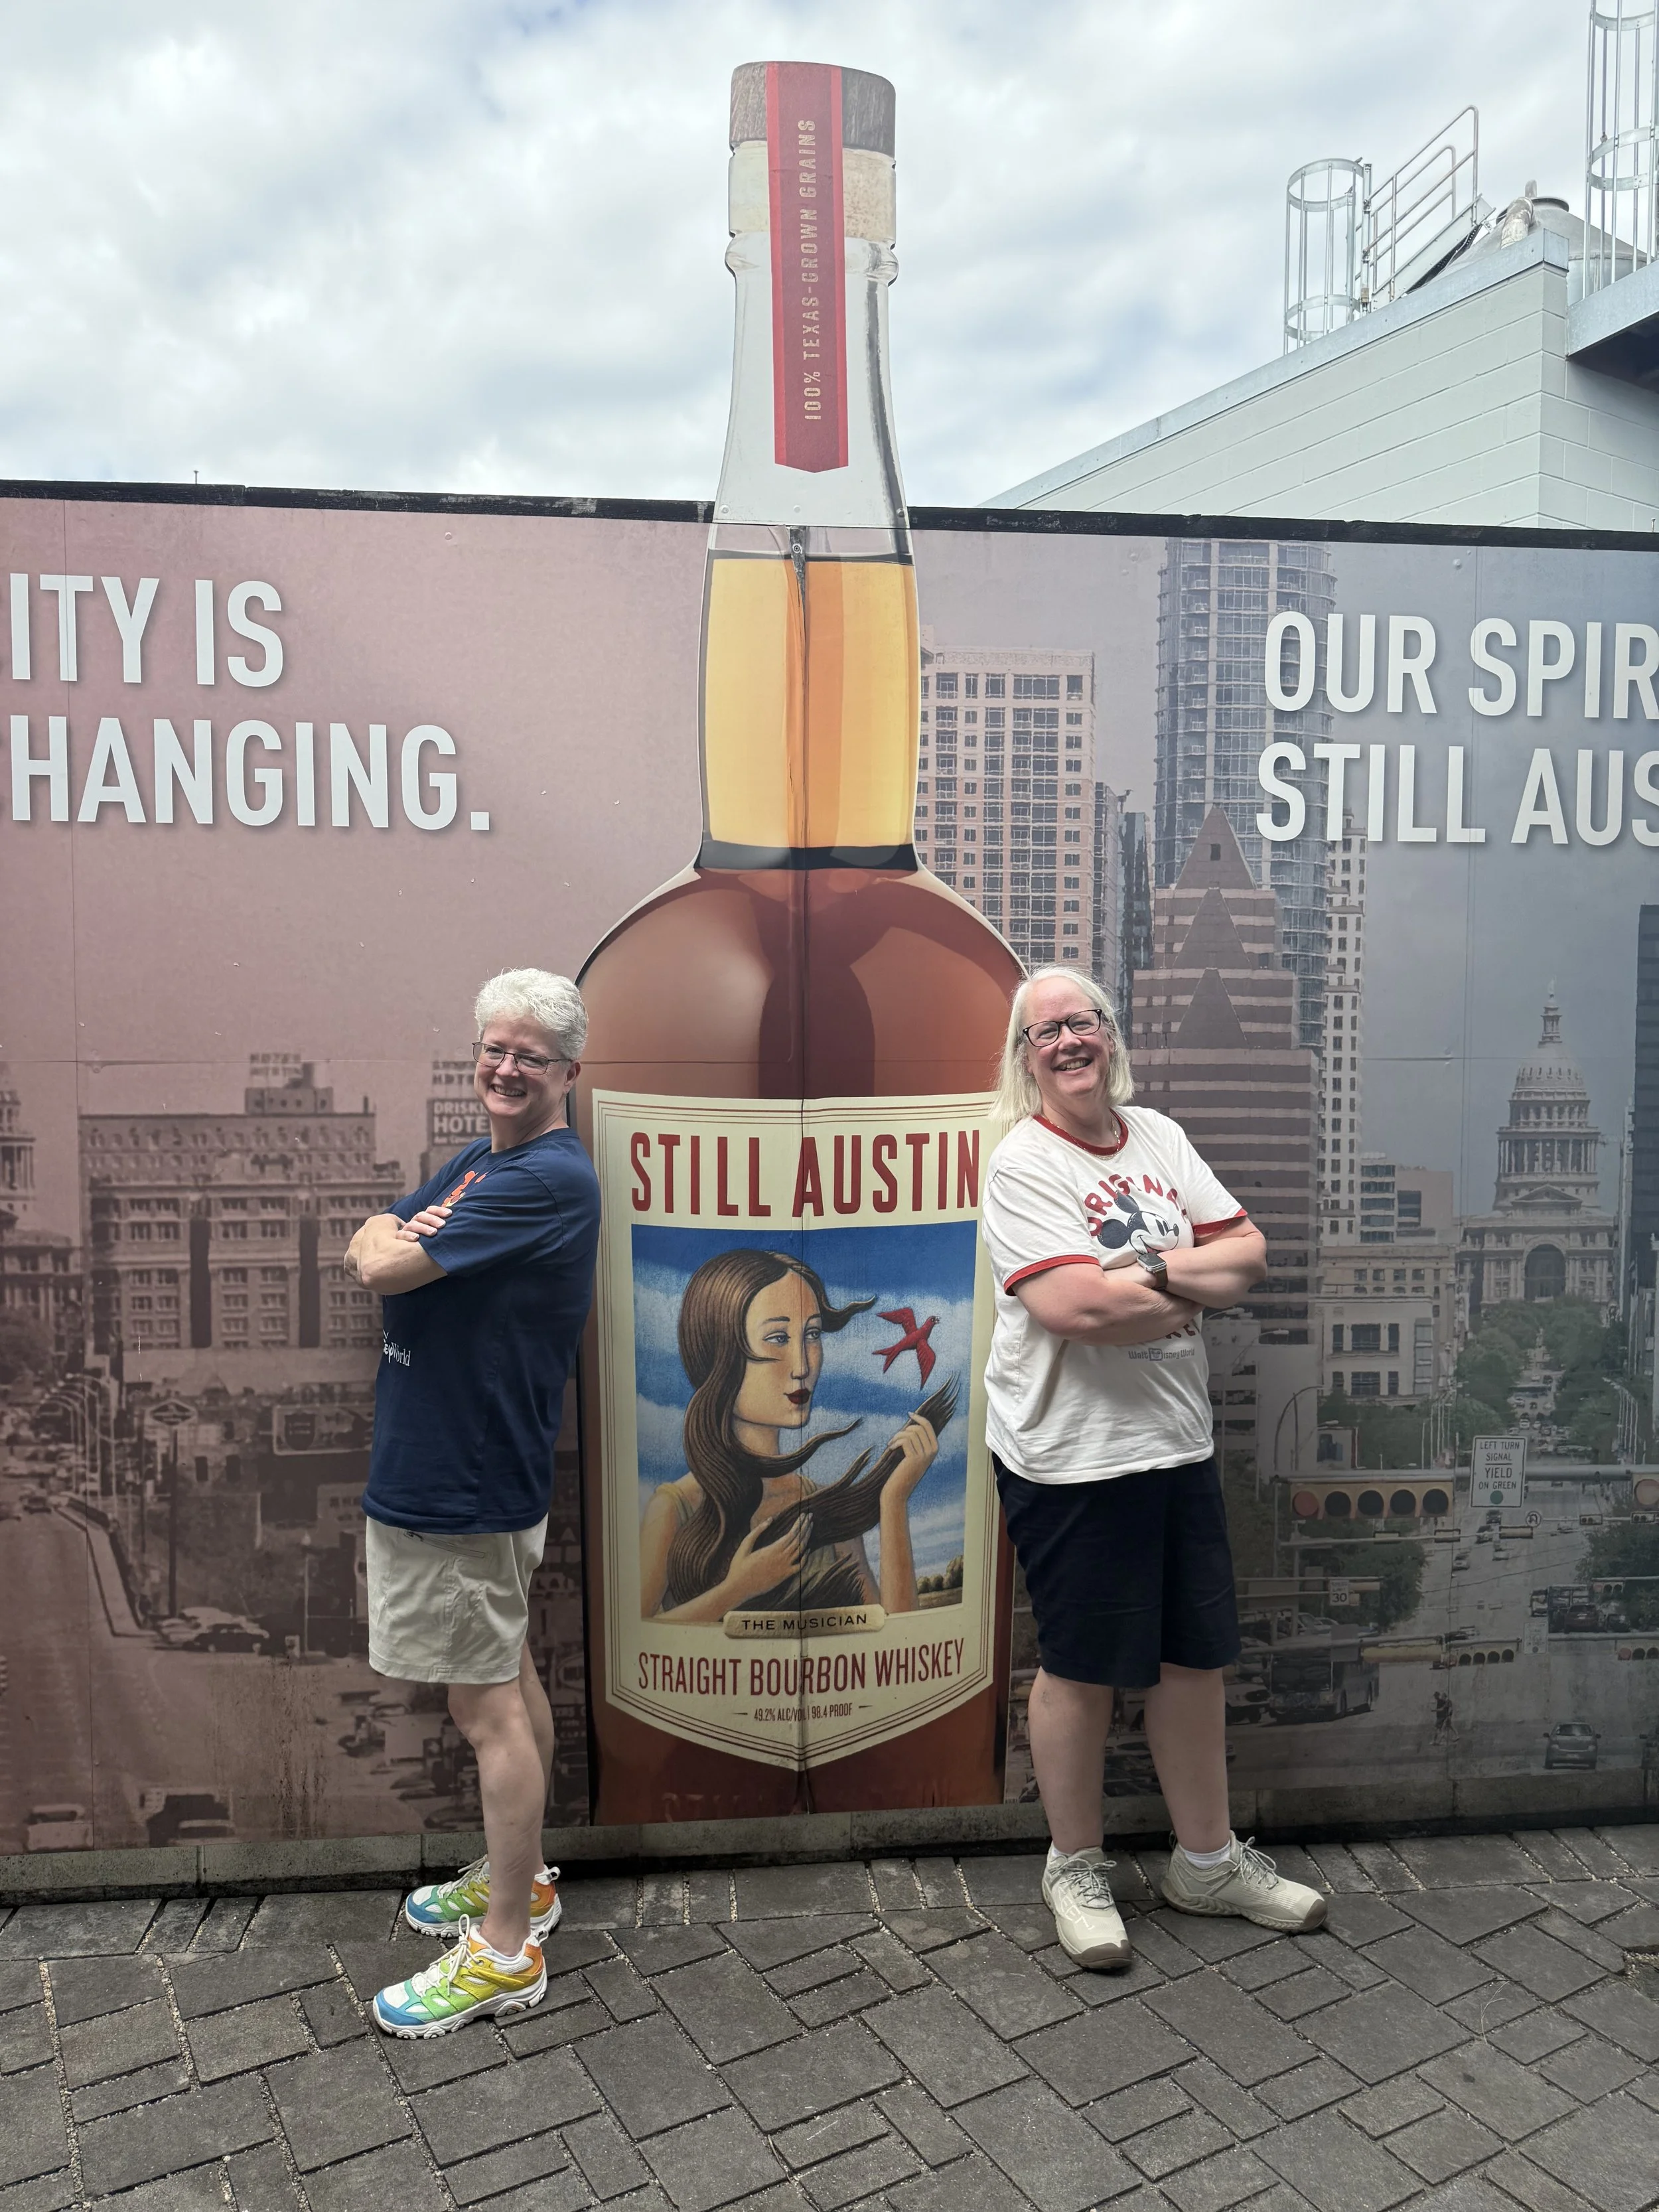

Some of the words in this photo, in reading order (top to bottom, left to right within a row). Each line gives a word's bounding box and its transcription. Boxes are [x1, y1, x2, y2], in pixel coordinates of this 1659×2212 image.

[798, 119, 816, 197] GRAINS
[801, 208, 820, 359] TEXAS-GROWN
[803, 372, 821, 420] 100%
[10, 573, 159, 684] ITY
[195, 579, 283, 688] IS
[1265, 611, 1437, 713] OUR
[1468, 618, 1659, 720] SPIR
[10, 715, 489, 831] HANGING.
[1256, 741, 1486, 843] STILL
[433, 1101, 488, 1114] DRISKI
[630, 1132, 771, 1217] STILL
[792, 1130, 980, 1218] AUSTIN
[1480, 1441, 1496, 1450] LEFT
[1501, 1441, 1520, 1450] TURN
[1486, 1453, 1512, 1461] SIGNAL
[1479, 1481, 1488, 1490] ON
[1493, 1481, 1516, 1490] GREEN
[1485, 1467, 1512, 1478] YIELD
[1332, 1593, 1347, 1603] 30
[742, 1619, 775, 1631] THE
[783, 1614, 867, 1631] MUSICIAN
[638, 1652, 741, 1696] STRAIGHT
[751, 1653, 865, 1696] BOURBON
[874, 1638, 965, 1687] WHISKEY
[754, 1708, 775, 1721] 49.2%
[812, 1705, 828, 1719] 98.4
[830, 1702, 853, 1718] PROOF
